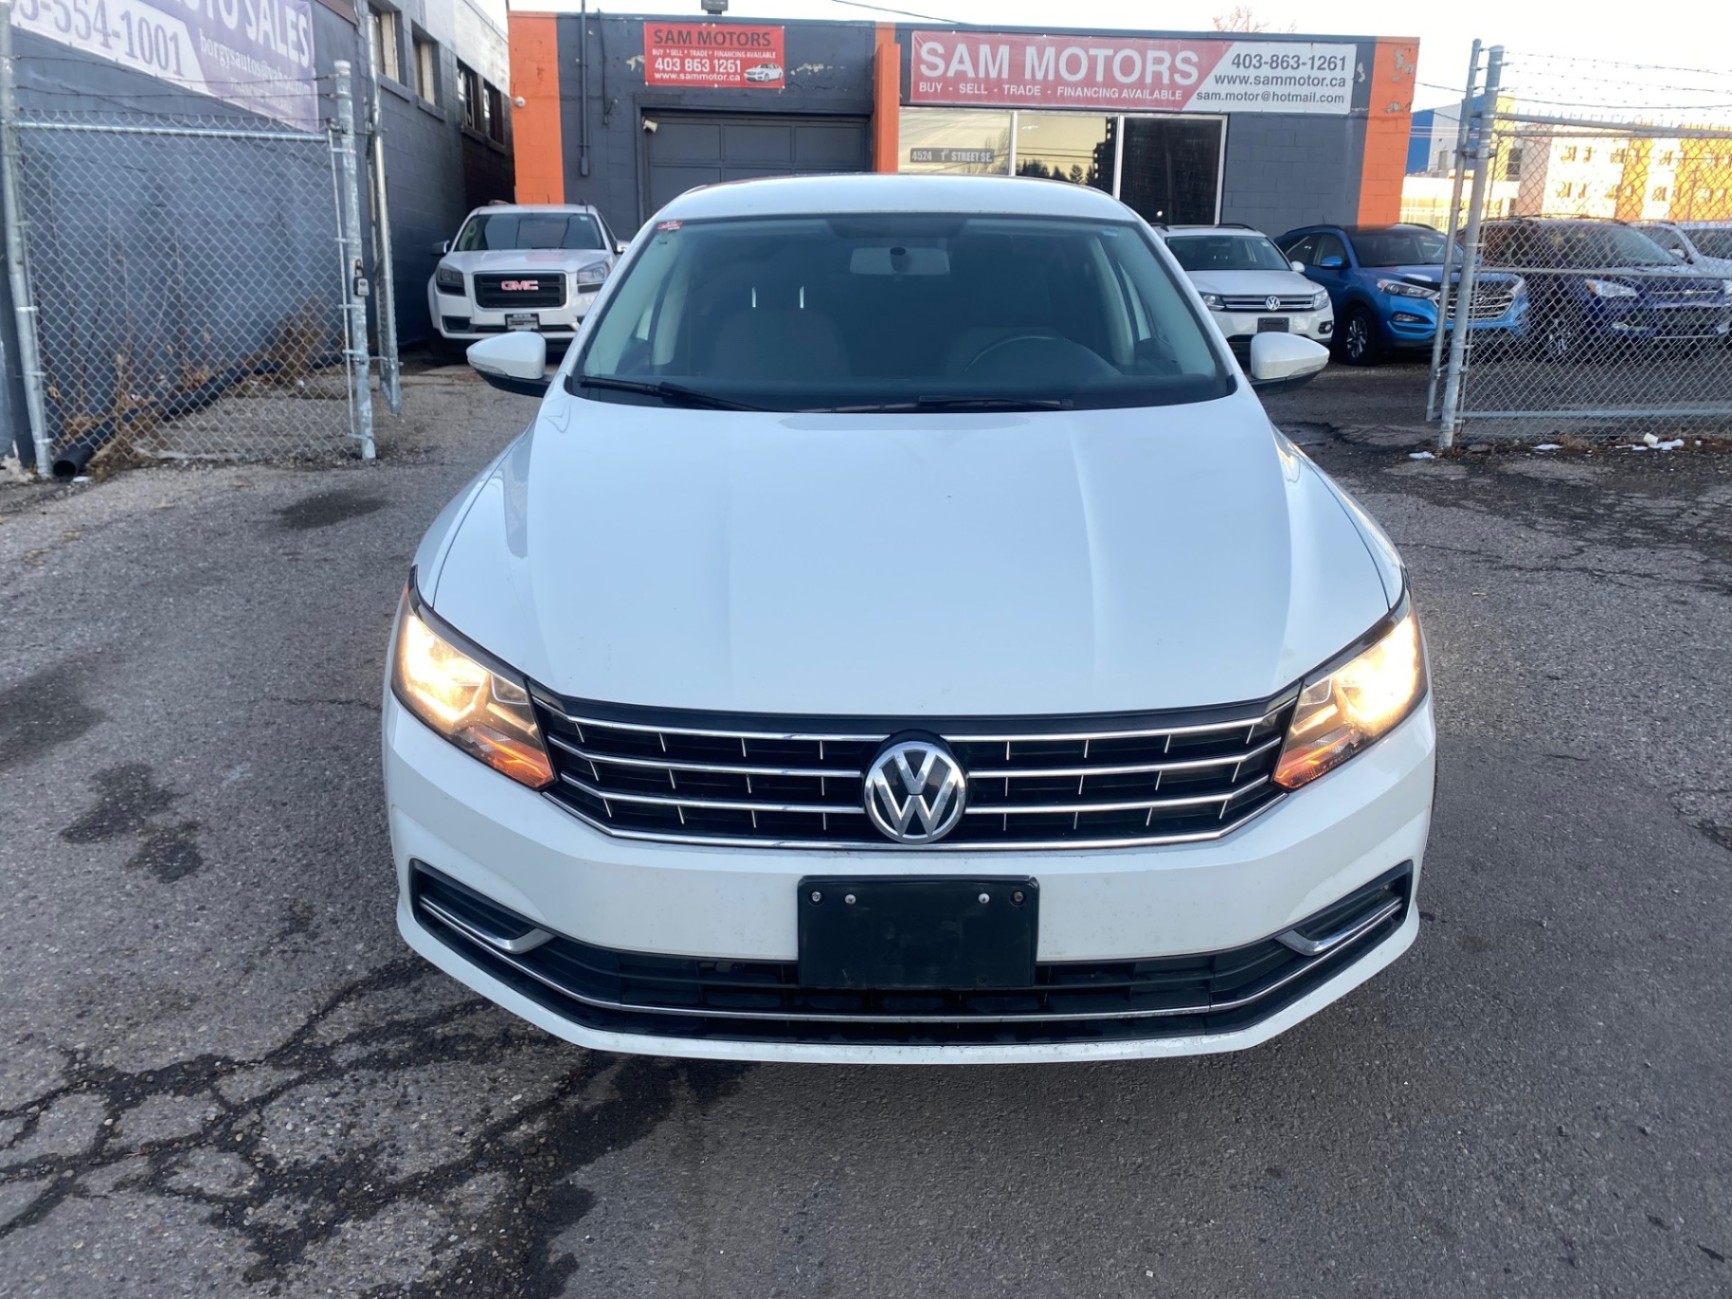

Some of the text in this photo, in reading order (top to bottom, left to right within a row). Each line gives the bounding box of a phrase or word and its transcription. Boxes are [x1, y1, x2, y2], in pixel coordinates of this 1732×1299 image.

[10, 0, 184, 77] -554-1001
[653, 29, 771, 46] SAM MOTORS
[714, 50, 745, 58] FINANCING
[655, 58, 740, 73] 403 863 1261
[919, 41, 1199, 85] SAM MOTORS
[1231, 53, 1347, 71] 403-863-1261
[654, 72, 740, 82] www.sammotor.ca
[1214, 74, 1346, 87] www.sammotor.ca
[919, 82, 943, 92] BUY
[959, 83, 987, 94] SELL
[1003, 84, 1041, 96] TRADE
[1057, 87, 1119, 99] FINANCING
[1122, 89, 1182, 100] AVAILABLE
[1196, 91, 1345, 104] sam.motor@hotmail.com
[911, 150, 932, 160] 4524
[952, 151, 979, 162] STREET
[501, 280, 538, 290] GMC
